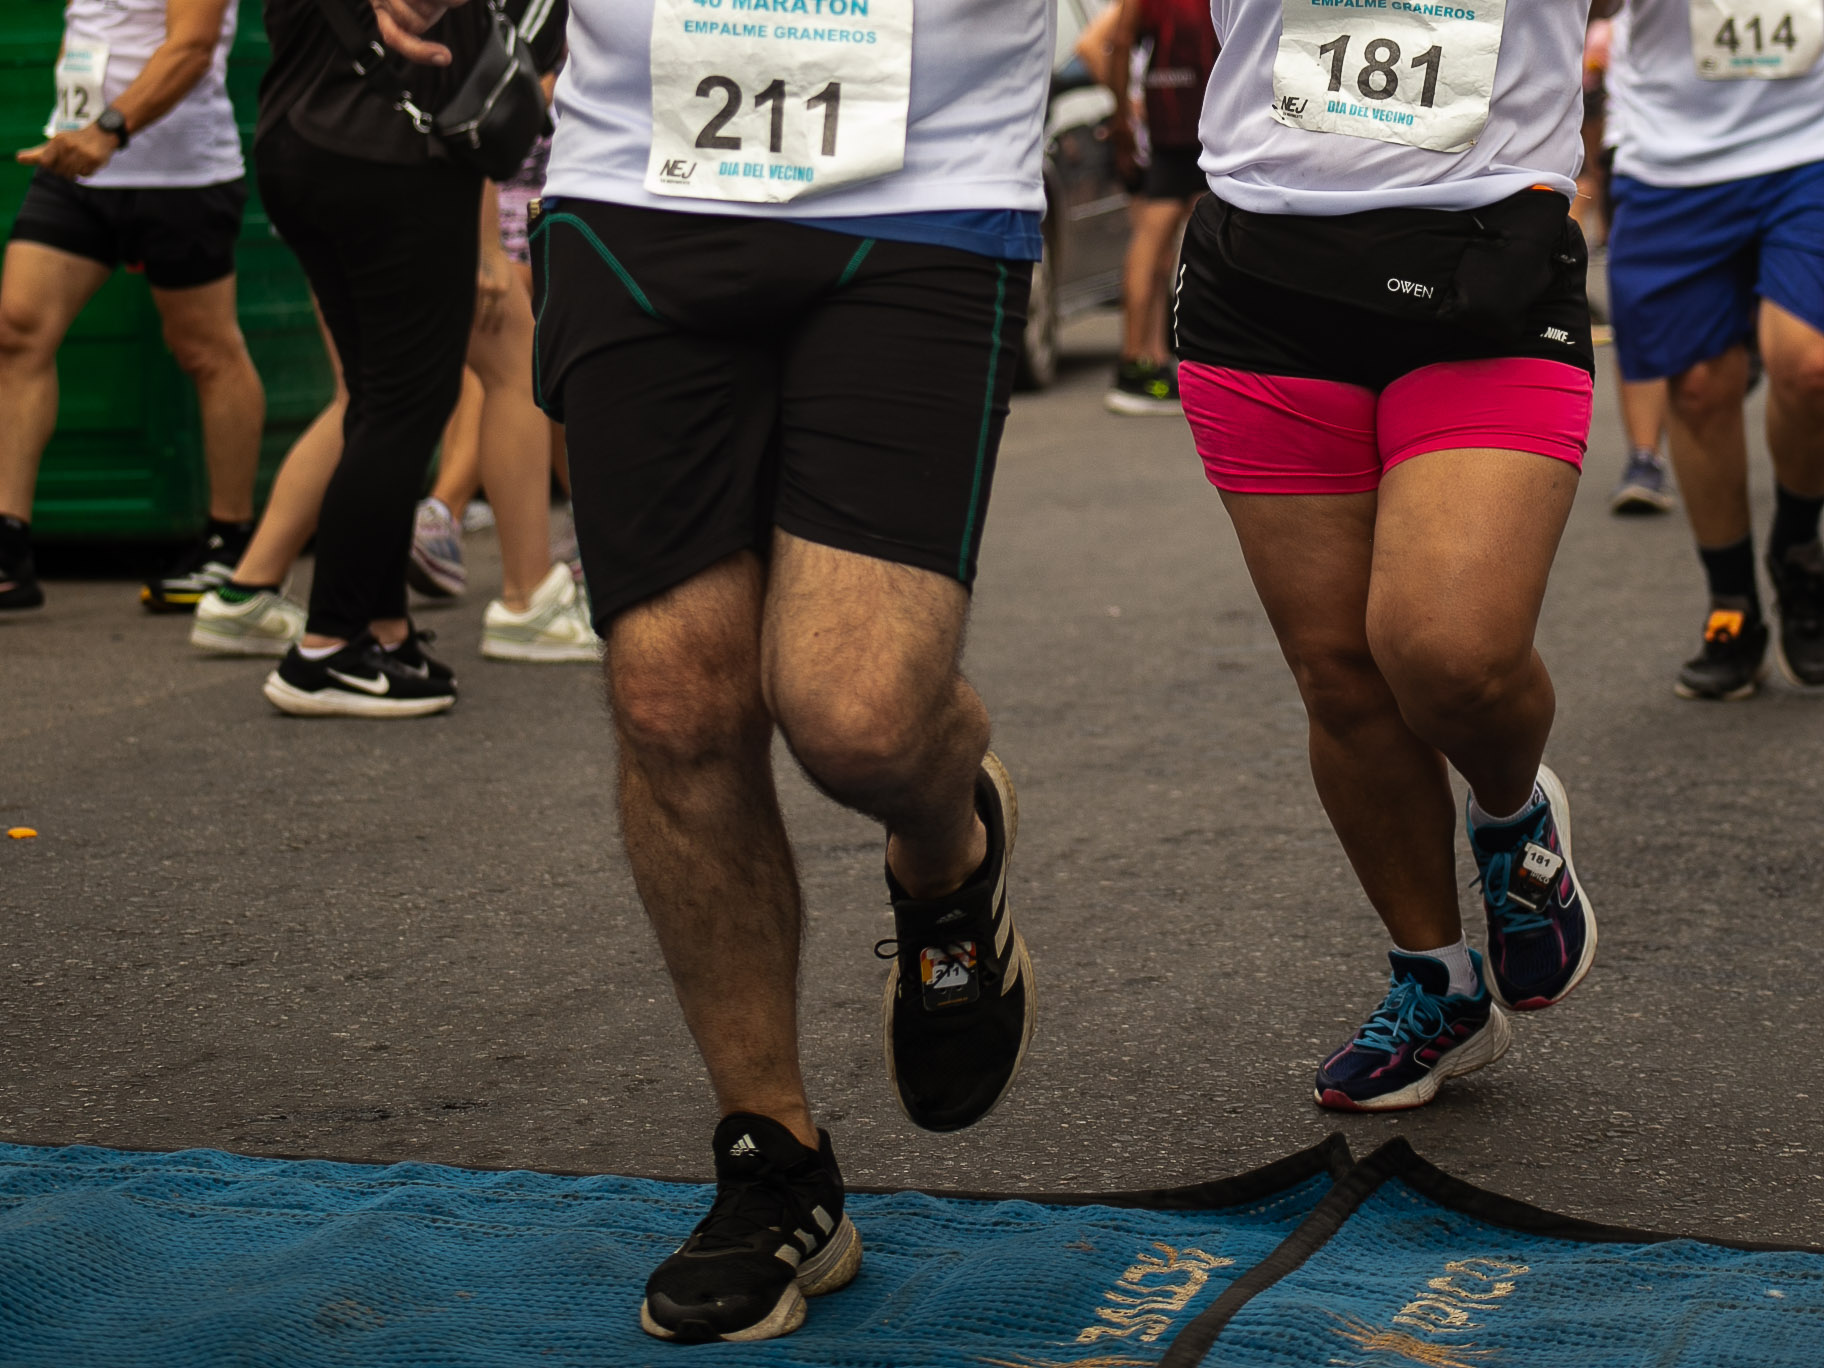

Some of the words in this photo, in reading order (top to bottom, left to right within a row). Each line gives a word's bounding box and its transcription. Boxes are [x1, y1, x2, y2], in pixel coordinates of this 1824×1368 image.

[1391, 1, 1475, 21] GRANEROS
[684, 20, 767, 37] EMPALME
[774, 26, 877, 44] GRANEROS
[1714, 13, 1797, 53] 414
[1319, 34, 1442, 109] 181
[694, 75, 841, 156] 211
[1281, 96, 1308, 113] NEJ
[1327, 100, 1347, 115] DIA
[1349, 103, 1369, 119] DEL
[1372, 107, 1414, 126] VECINO
[660, 159, 697, 179] NEJ
[719, 161, 739, 177] DIA
[743, 162, 765, 179] DEL
[769, 164, 814, 182] VECINO
[1386, 277, 1434, 300] OWEN
[1544, 326, 1568, 343] NIKE
[1530, 852, 1551, 868] 181
